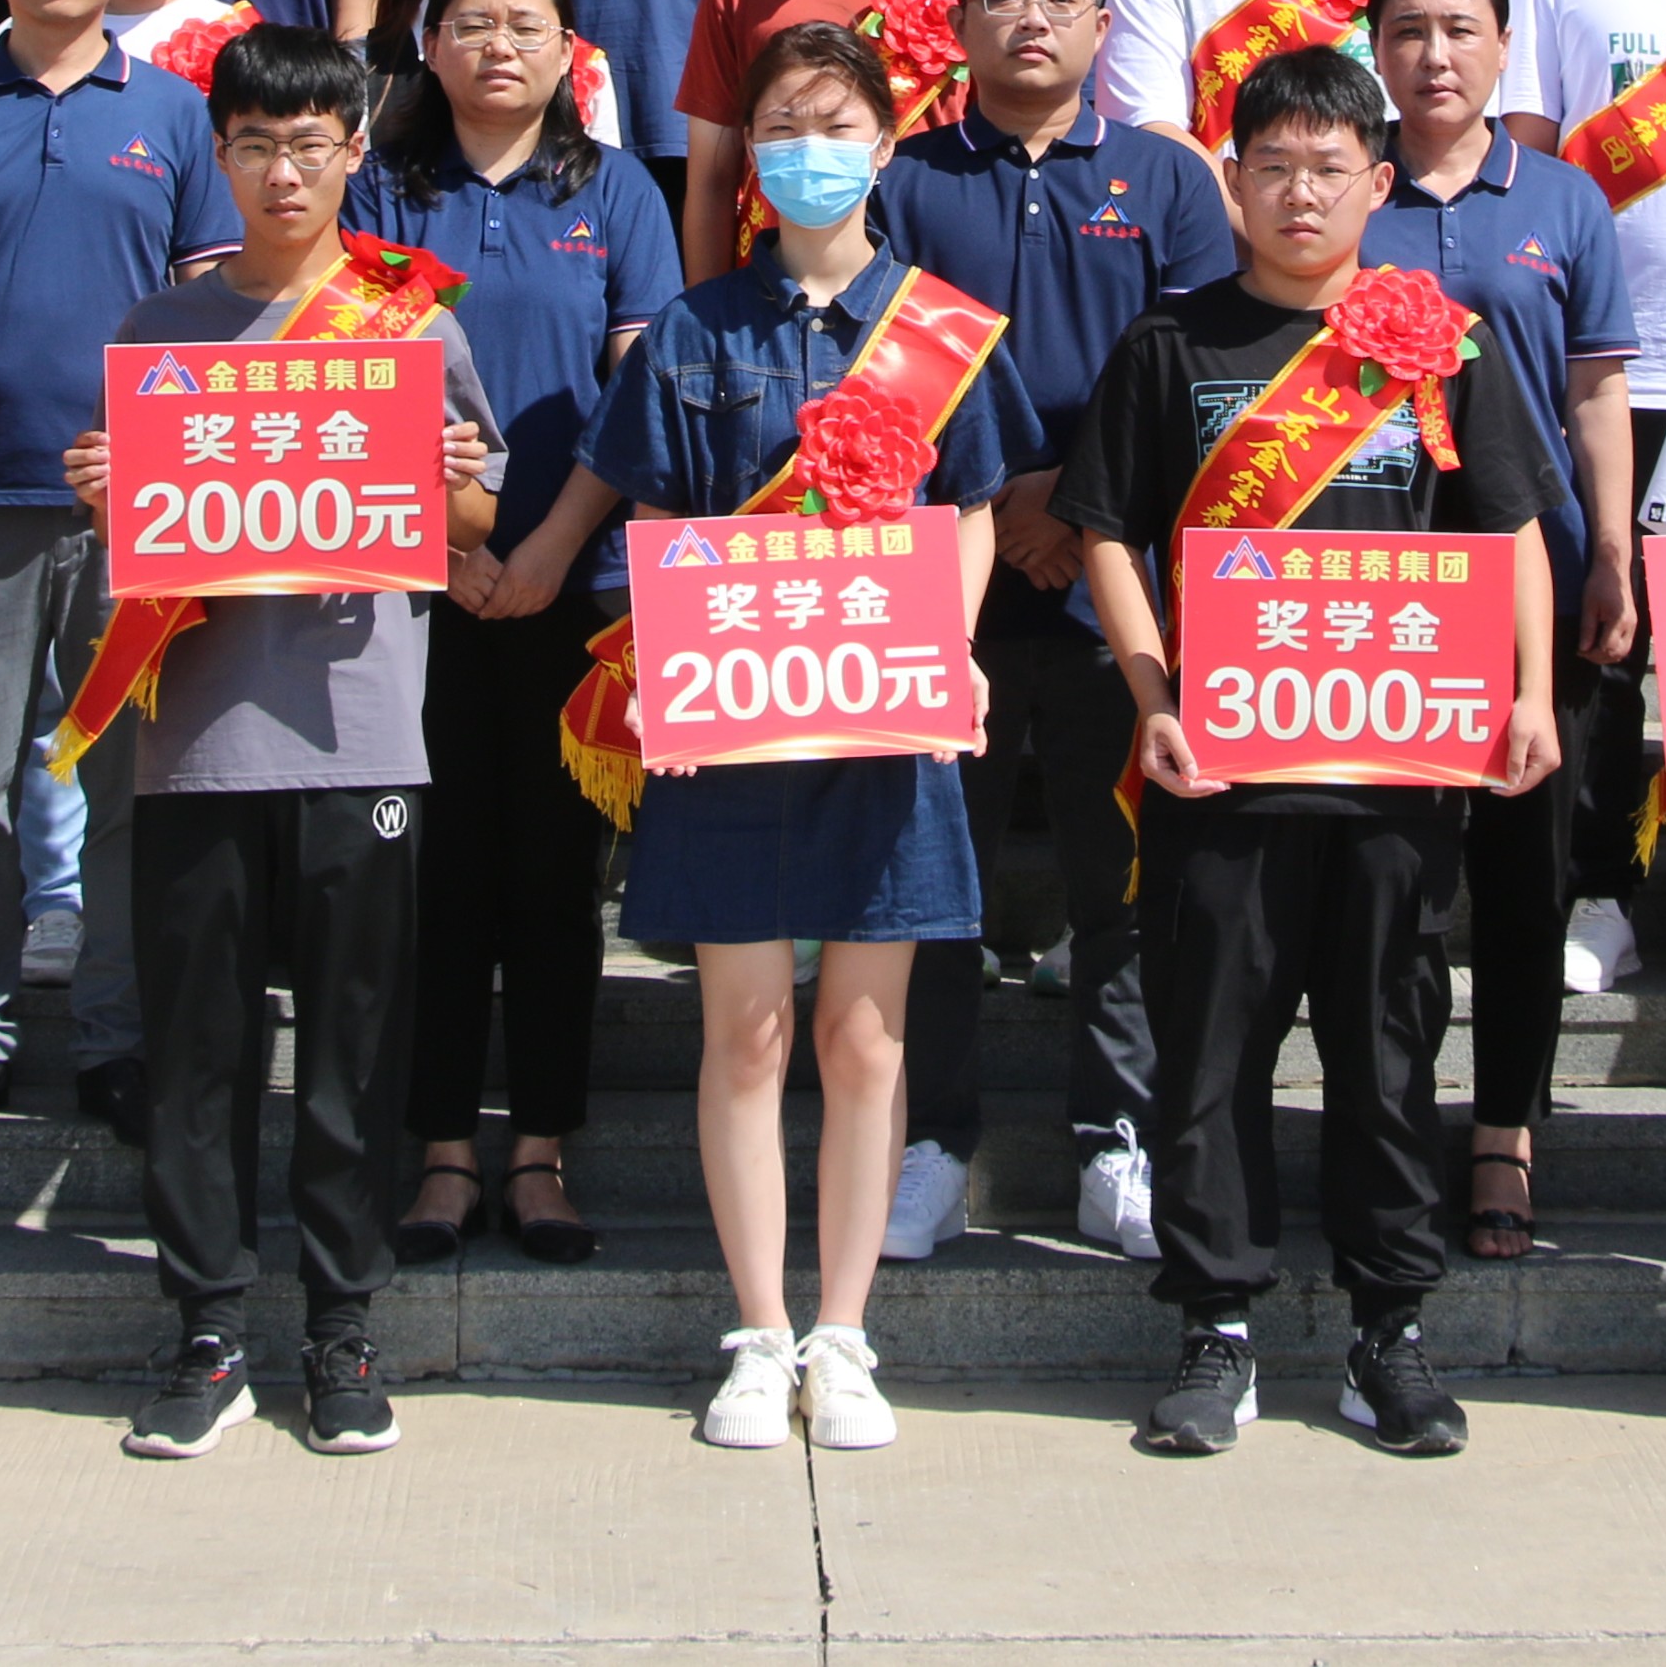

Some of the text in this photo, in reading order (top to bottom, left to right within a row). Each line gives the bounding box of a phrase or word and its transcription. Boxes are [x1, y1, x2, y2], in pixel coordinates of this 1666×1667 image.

[1609, 32, 1661, 56] FULL
[205, 358, 396, 393] 金玺泰集团
[183, 410, 369, 465] 奖学金
[133, 478, 422, 554] 2000元
[725, 524, 913, 564] 金玺泰集团
[1281, 548, 1469, 582] 金玺泰集团
[706, 576, 891, 634] 奖学金
[1256, 600, 1440, 653] 奖学金
[660, 642, 949, 723] 2000元
[1205, 666, 1490, 743] 3000元
